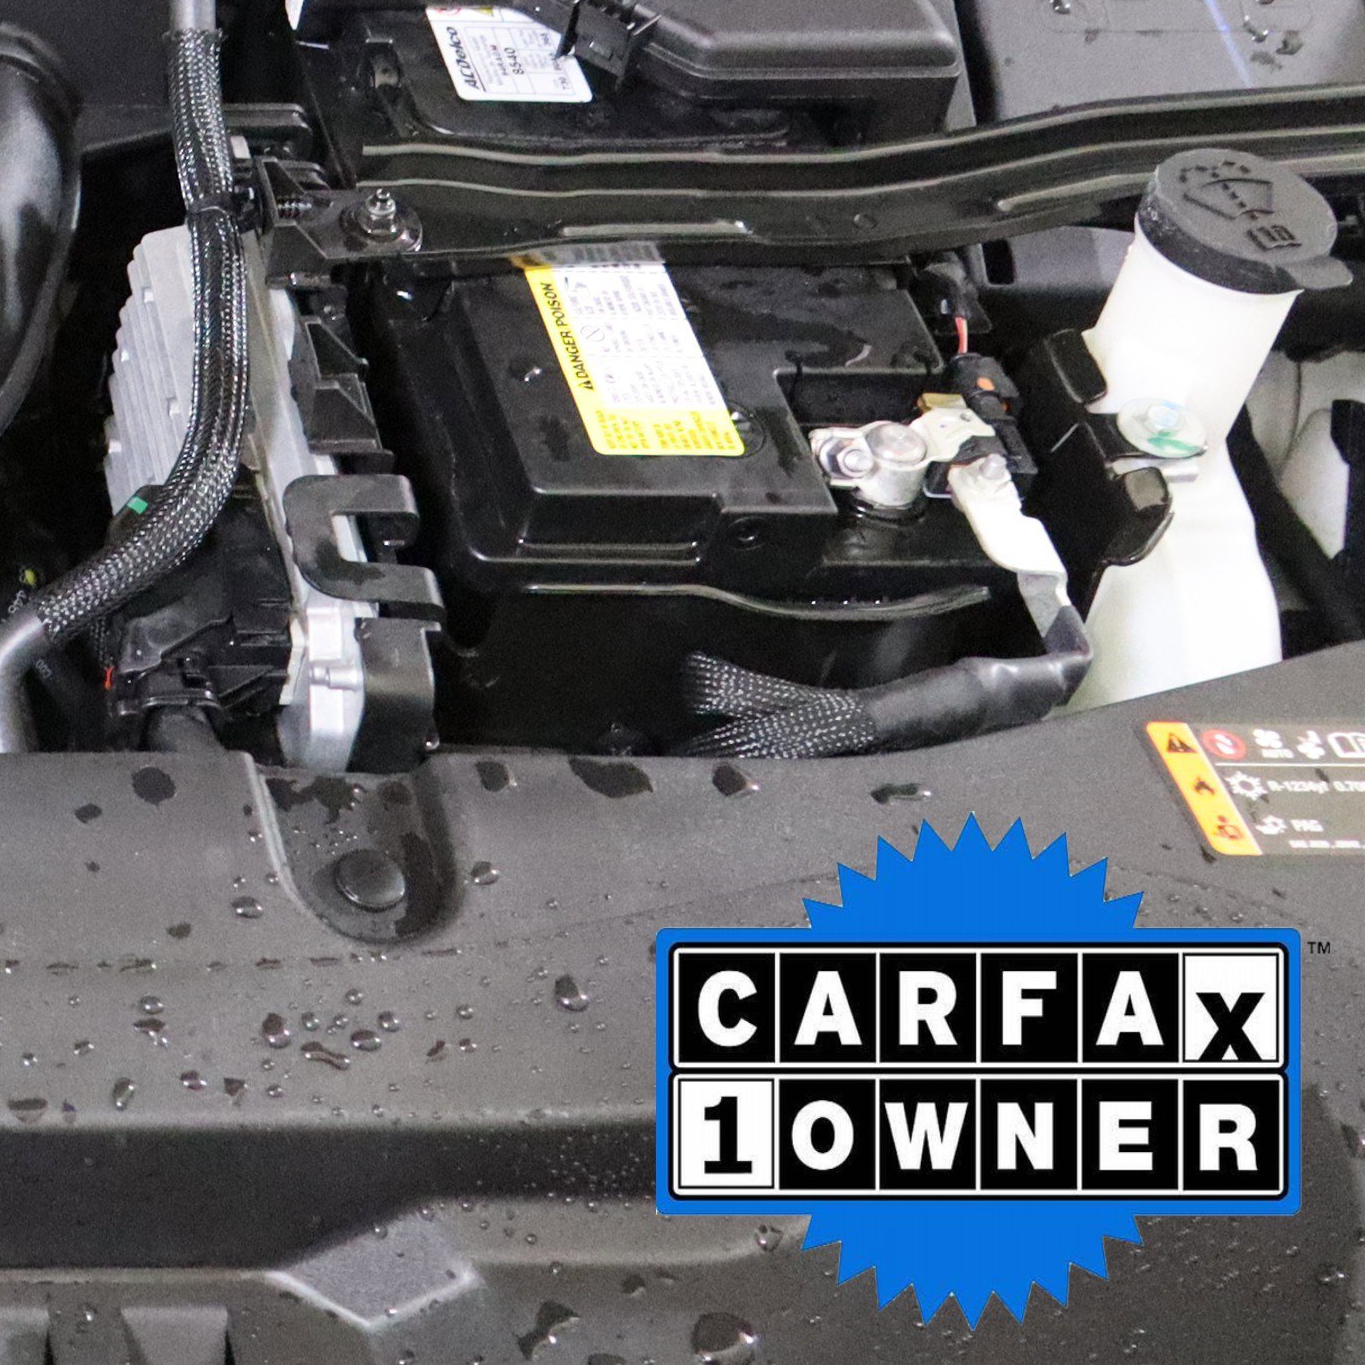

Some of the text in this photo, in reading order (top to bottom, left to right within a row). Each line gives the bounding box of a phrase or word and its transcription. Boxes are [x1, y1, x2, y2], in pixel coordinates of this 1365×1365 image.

[445, 26, 480, 91] ACDelco
[540, 282, 589, 381] DANGER POISON
